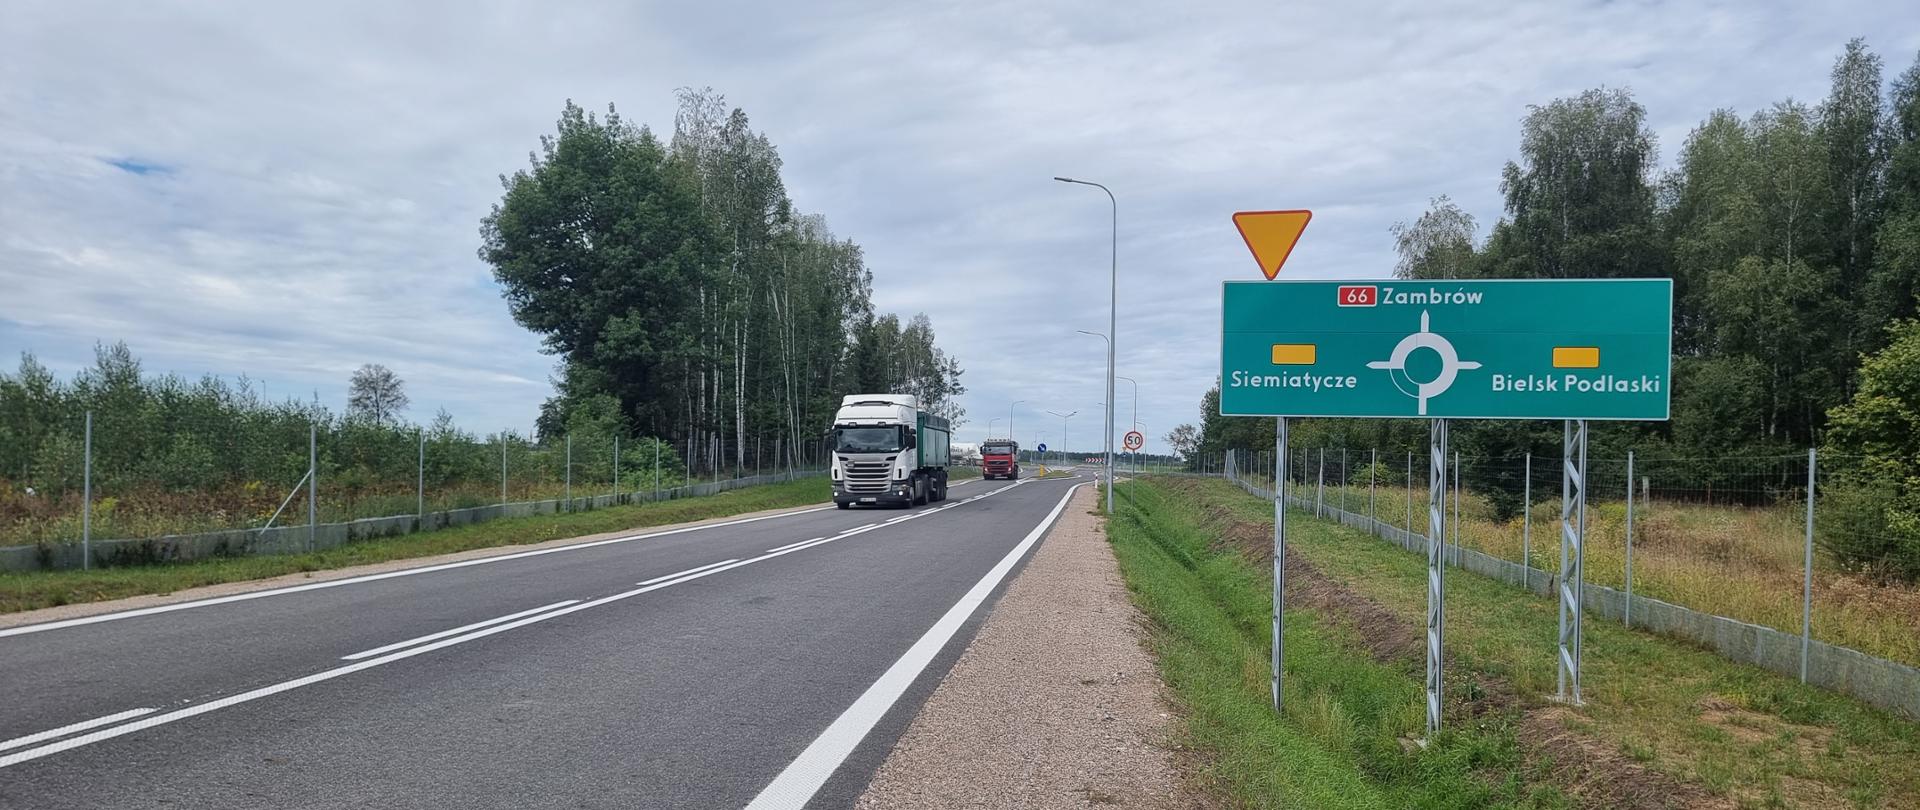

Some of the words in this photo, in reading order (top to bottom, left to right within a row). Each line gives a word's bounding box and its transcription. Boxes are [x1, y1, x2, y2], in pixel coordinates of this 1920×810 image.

[1347, 288, 1368, 303] 66
[1383, 287, 1483, 305] Zambrów
[1231, 370, 1357, 393] Siemiatycze
[1492, 374, 1558, 392] Bielsk
[1565, 374, 1660, 393] Podlaski
[1127, 435, 1141, 445] 50
